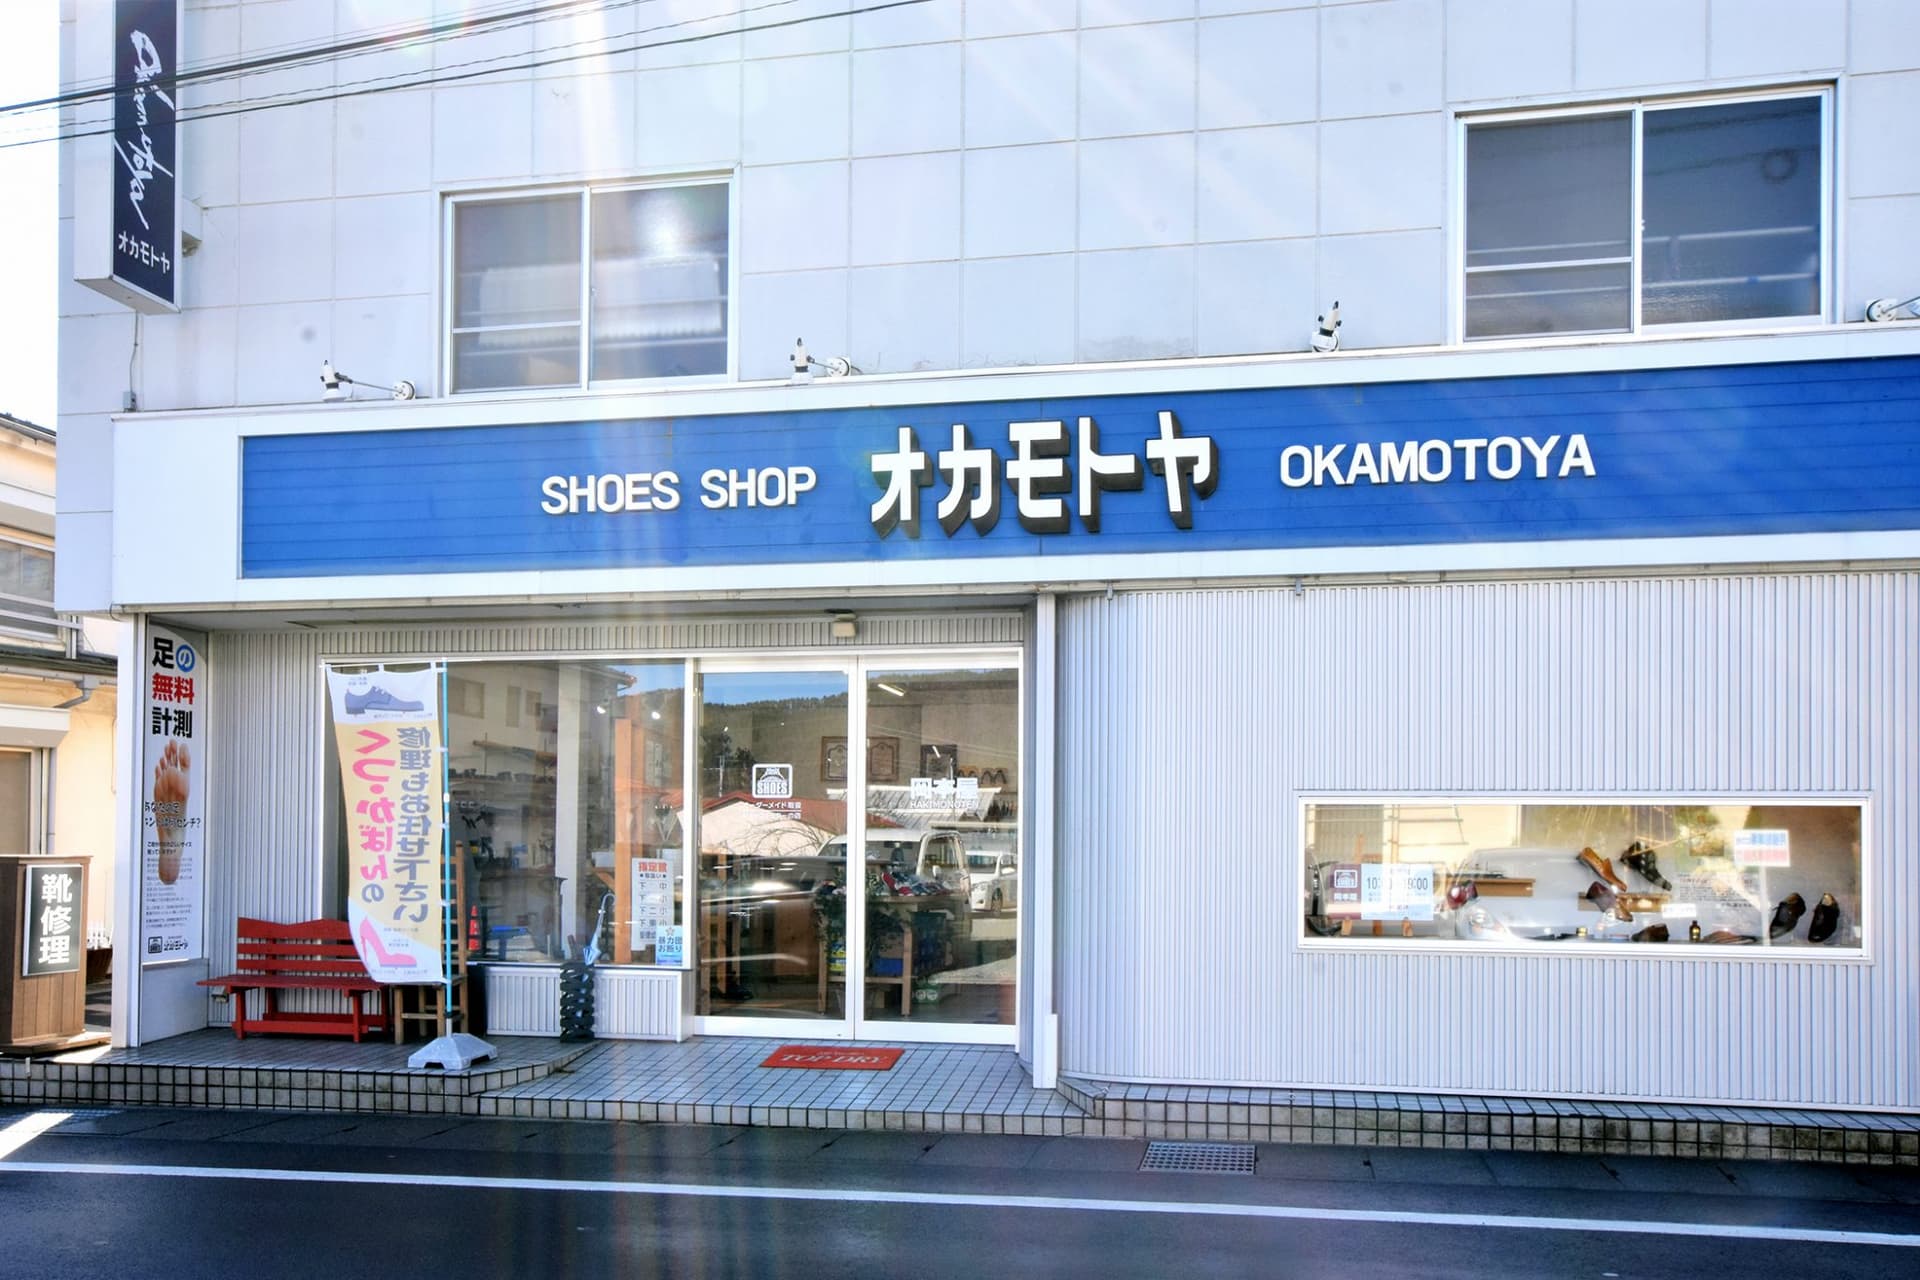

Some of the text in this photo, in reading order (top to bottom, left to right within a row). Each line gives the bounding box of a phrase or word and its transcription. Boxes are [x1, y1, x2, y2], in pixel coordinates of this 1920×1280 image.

[118, 230, 171, 275] オカモトヤ
[870, 410, 1217, 538] オカモトヤ
[1279, 433, 1597, 488] OKAMOTOYA
[541, 465, 817, 515] SHOES SHOP
[152, 637, 196, 672] 足の
[152, 673, 195, 704] 無料
[152, 706, 193, 738] 計測
[38, 873, 73, 964] 靴修理
